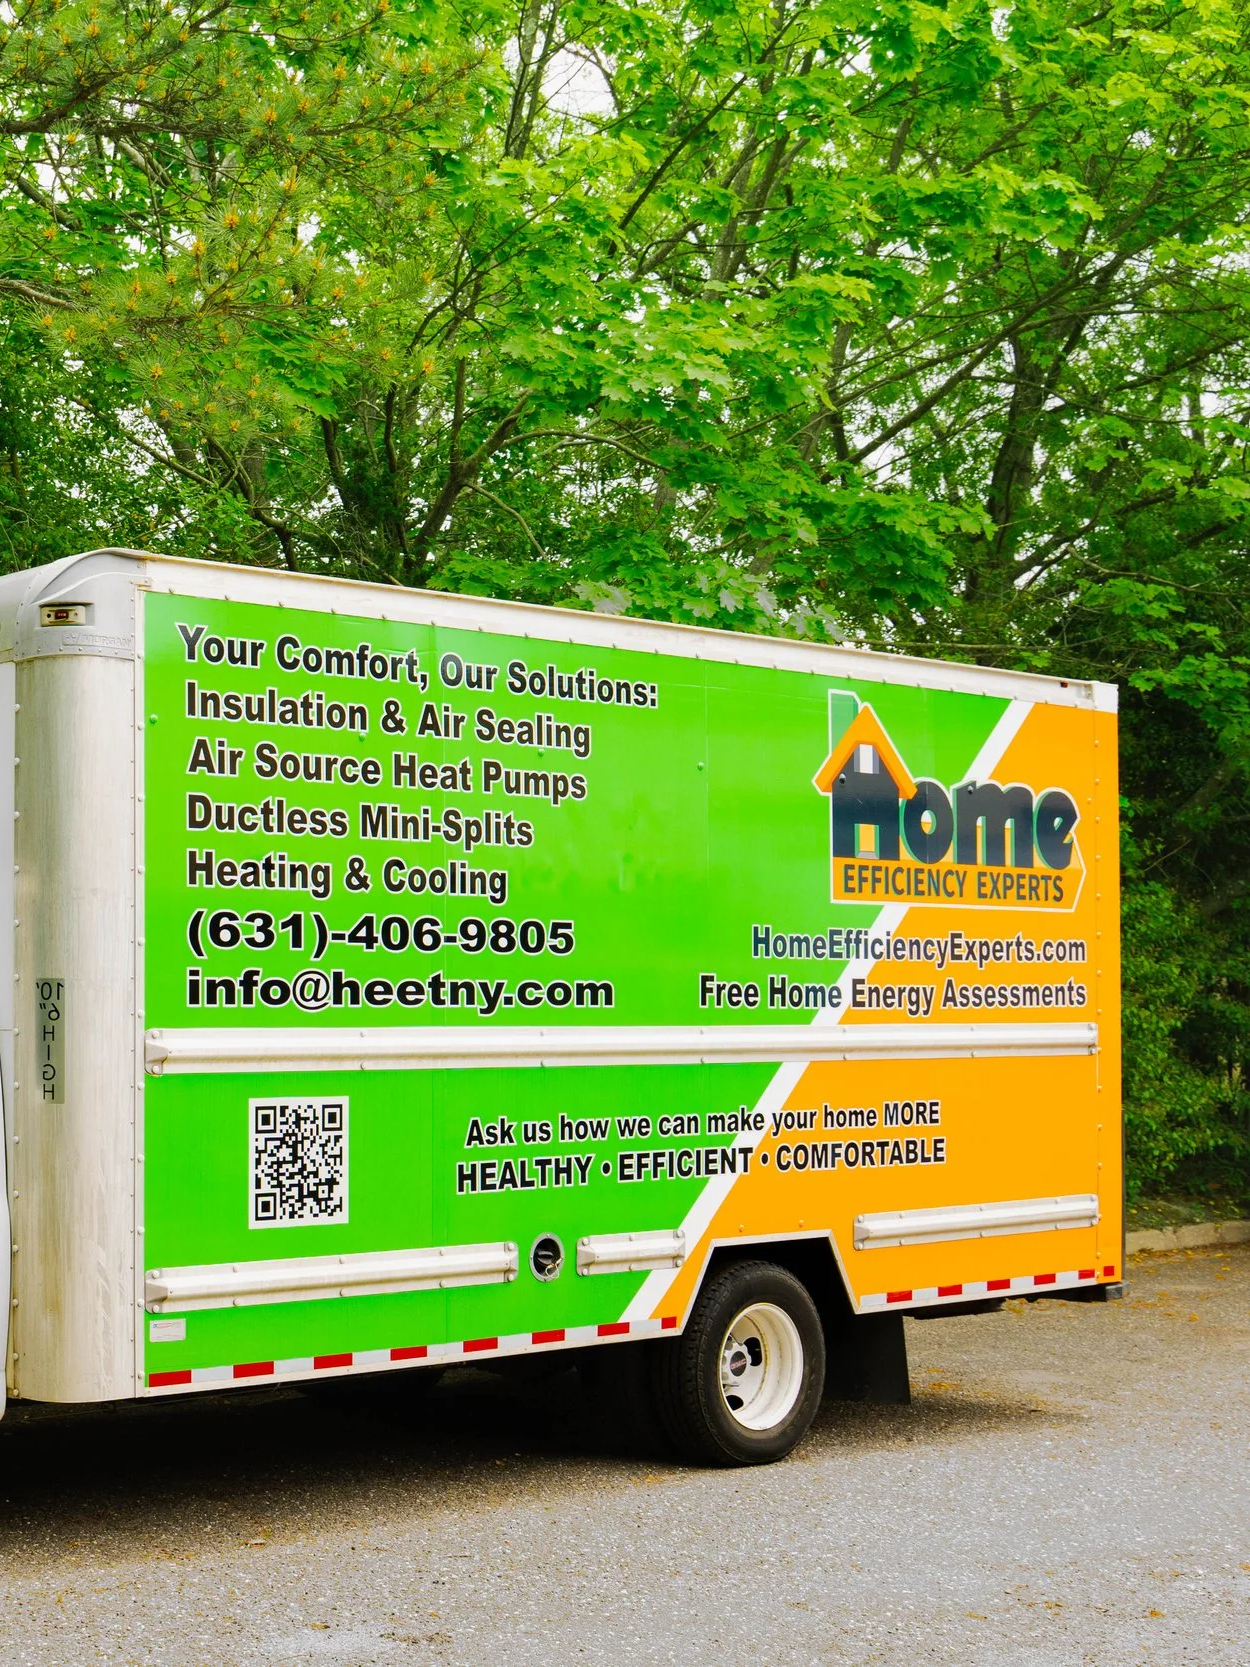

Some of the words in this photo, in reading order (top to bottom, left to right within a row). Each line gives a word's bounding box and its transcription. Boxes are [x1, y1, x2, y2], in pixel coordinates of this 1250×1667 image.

[176, 622, 265, 669] Your
[276, 635, 429, 691] Comfort,
[439, 653, 497, 691] Our
[507, 661, 658, 709] Solutions:
[185, 681, 368, 730] Insulation
[380, 699, 407, 735] &
[417, 703, 466, 740] Air
[475, 708, 592, 759] Sealing
[188, 737, 243, 777] Air
[254, 742, 381, 787] Source
[393, 752, 471, 792] Heat
[482, 760, 588, 807] Pumps
[186, 793, 348, 837] Ductless
[360, 803, 535, 851] Mini-Splits
[187, 850, 332, 898] Heating
[344, 857, 372, 893] &
[382, 857, 508, 903] Cooling
[843, 864, 968, 899] EFFICIENCY
[977, 871, 1063, 903] EXPERTS
[187, 909, 575, 959] (631)-406-9805
[751, 924, 1087, 969] HomeEfficiencyExperts.com
[187, 968, 615, 1016] info@heetny.com
[699, 973, 760, 1009] Free
[768, 974, 843, 1010] Home
[851, 977, 935, 1017] Energy
[941, 977, 1087, 1009] Assessments
[465, 1118, 514, 1148] Ask
[523, 1121, 552, 1144] us
[558, 1114, 609, 1141] how
[616, 1116, 651, 1139] we
[658, 1113, 699, 1136] can
[707, 1105, 765, 1135] make
[771, 1109, 817, 1136] your
[822, 1102, 877, 1129] home
[883, 1100, 940, 1127] MORE
[457, 1154, 593, 1194] HEALTHY
[618, 1146, 754, 1181] EFFICIENT
[776, 1137, 946, 1172] COMFORTABLE
